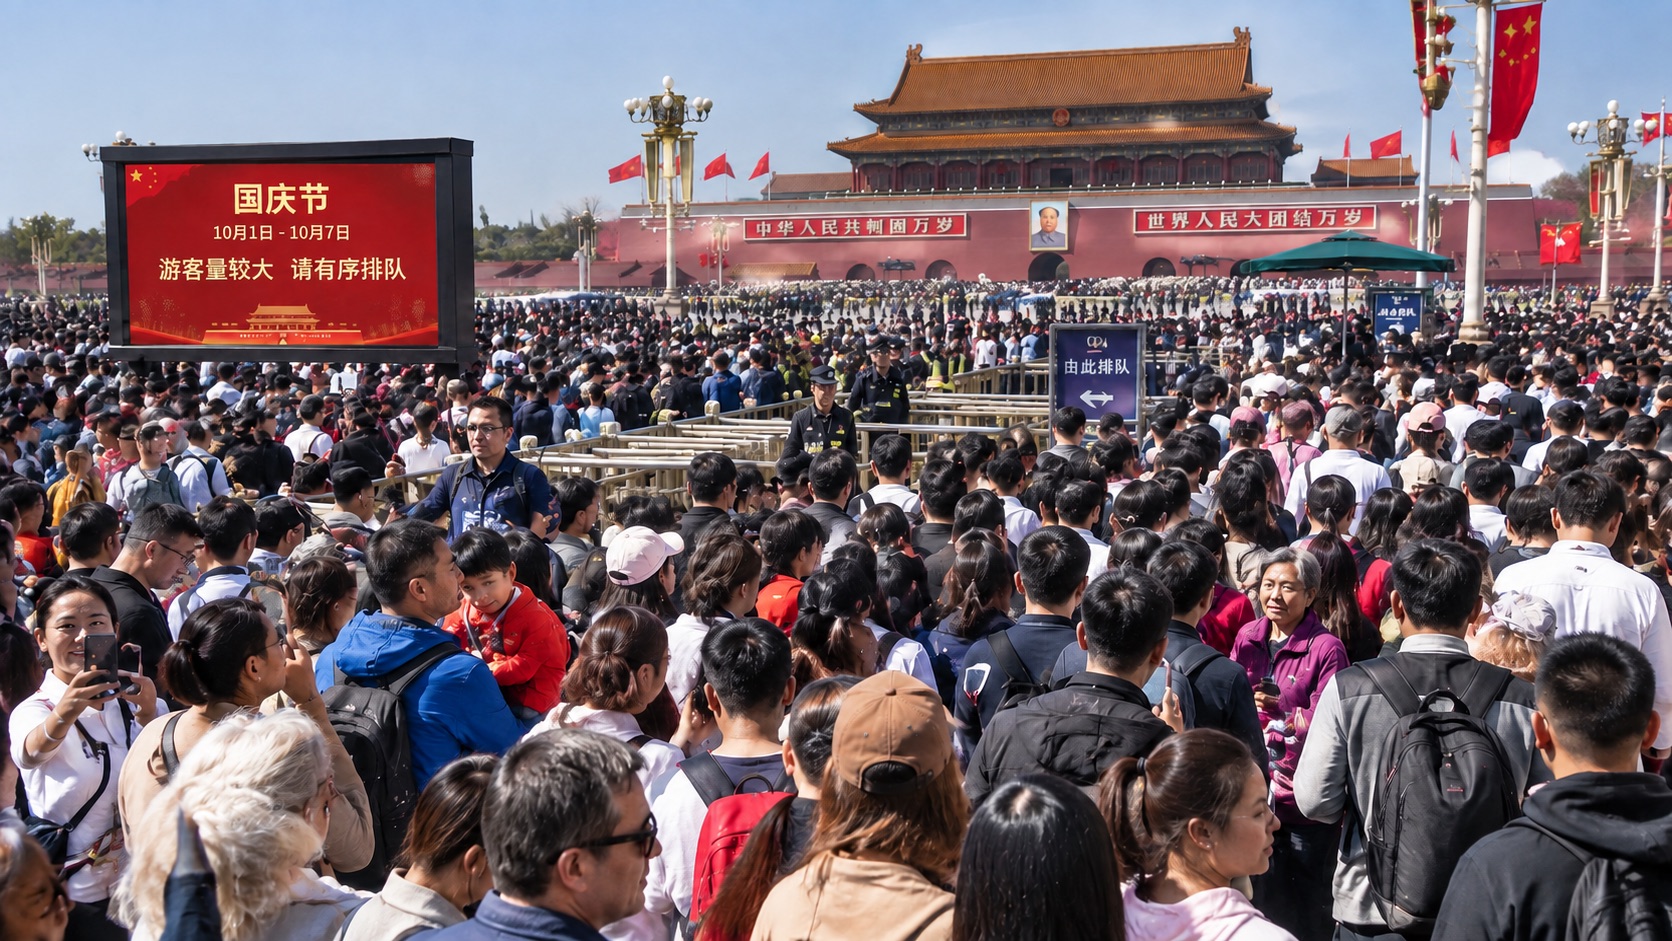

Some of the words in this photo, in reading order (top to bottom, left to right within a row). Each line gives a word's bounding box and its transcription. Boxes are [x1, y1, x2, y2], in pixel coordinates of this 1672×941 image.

[234, 183, 330, 215] 国庆节
[1147, 208, 1362, 230] 世界人民大团结万岁
[213, 225, 273, 241] 10月1日
[290, 225, 350, 241] 10月7日
[158, 257, 274, 281] 游客量较大
[291, 256, 407, 281] 请有序排队
[1064, 358, 1130, 375] 由此排队
